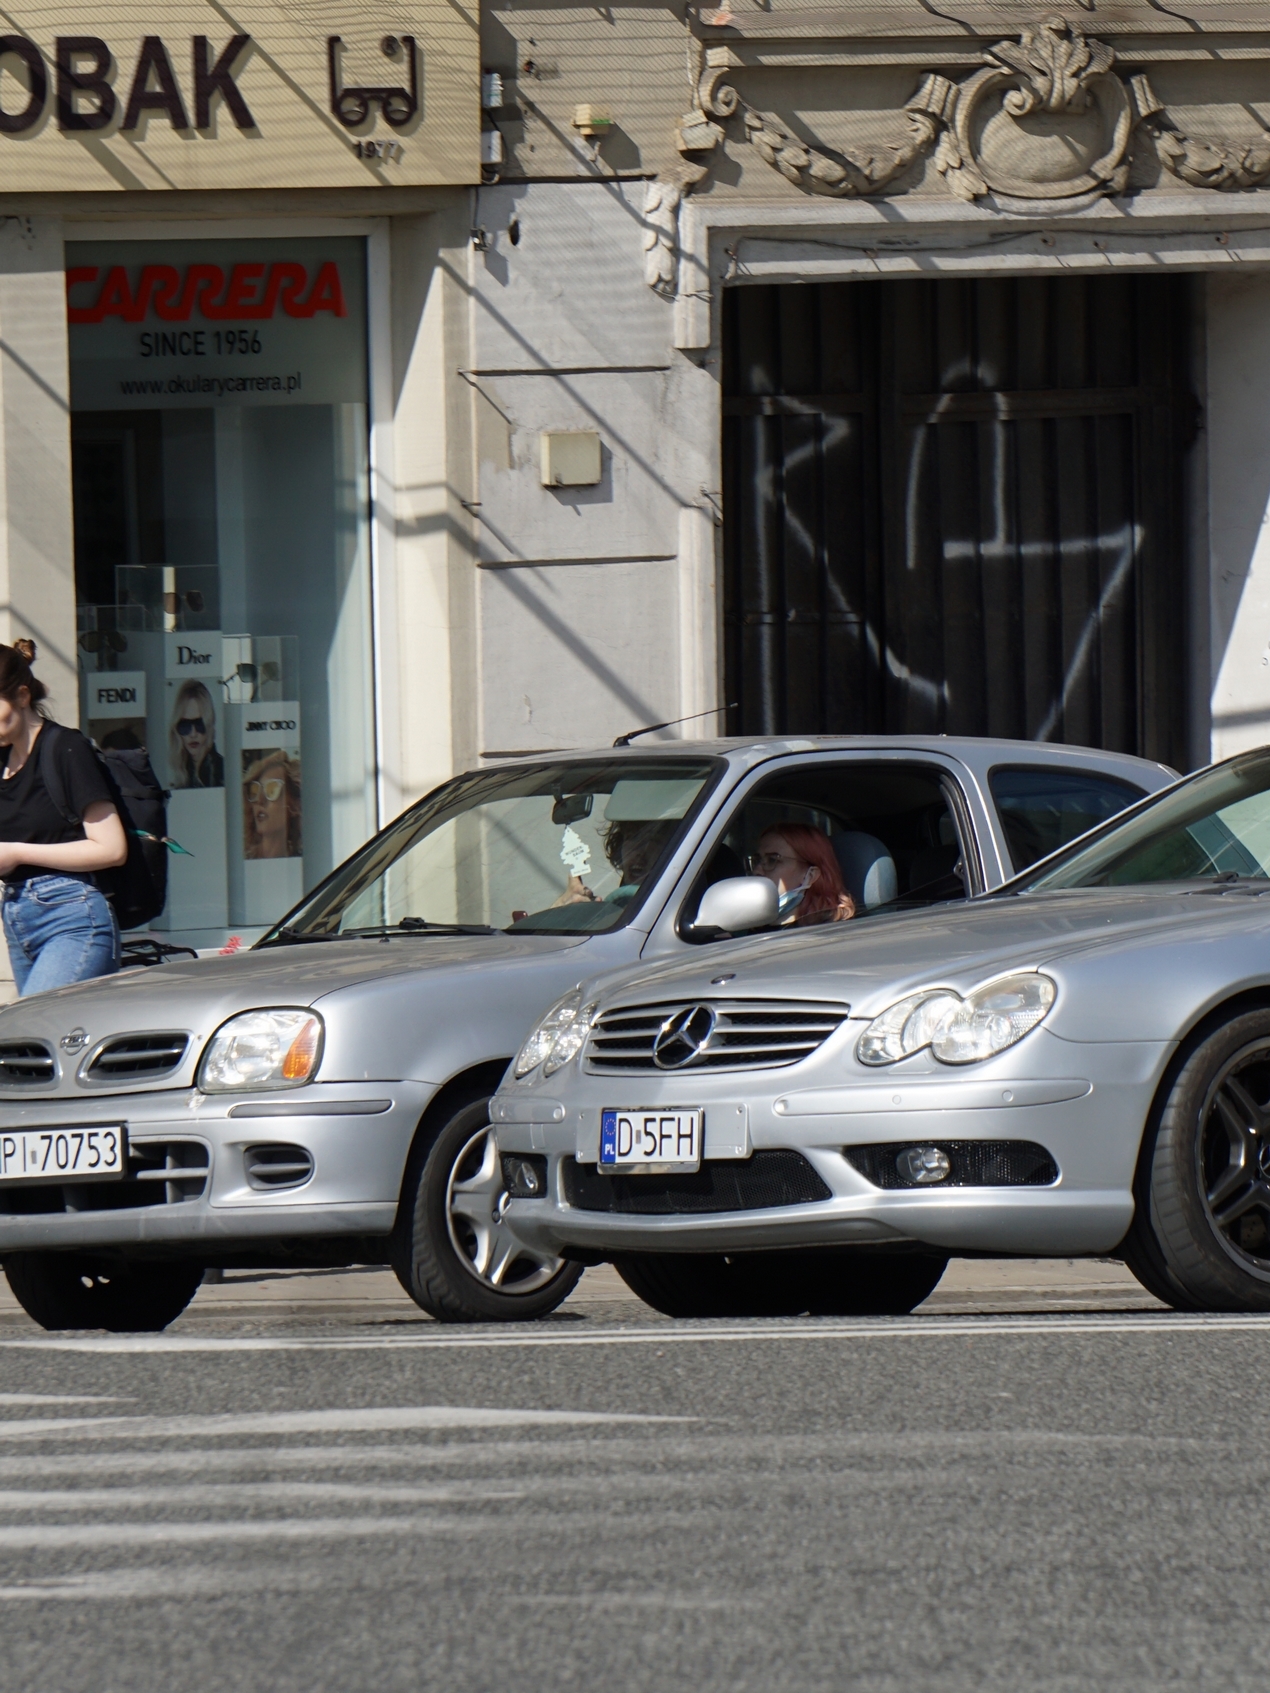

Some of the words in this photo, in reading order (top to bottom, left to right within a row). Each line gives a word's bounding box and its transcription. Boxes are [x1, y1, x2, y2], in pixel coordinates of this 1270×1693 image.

[353, 140, 399, 159] 1977
[65, 262, 348, 323] CARRERA
[140, 331, 206, 357] SINCE
[213, 329, 262, 355] 1956
[120, 371, 301, 398] www.okularycarrera.pl
[177, 646, 212, 665] Dior
[97, 687, 137, 704] FENDI
[604, 1143, 615, 1156] PL
[643, 1116, 694, 1157] 5FH
[0, 1136, 27, 1174] PI
[40, 1131, 118, 1171] 70753
